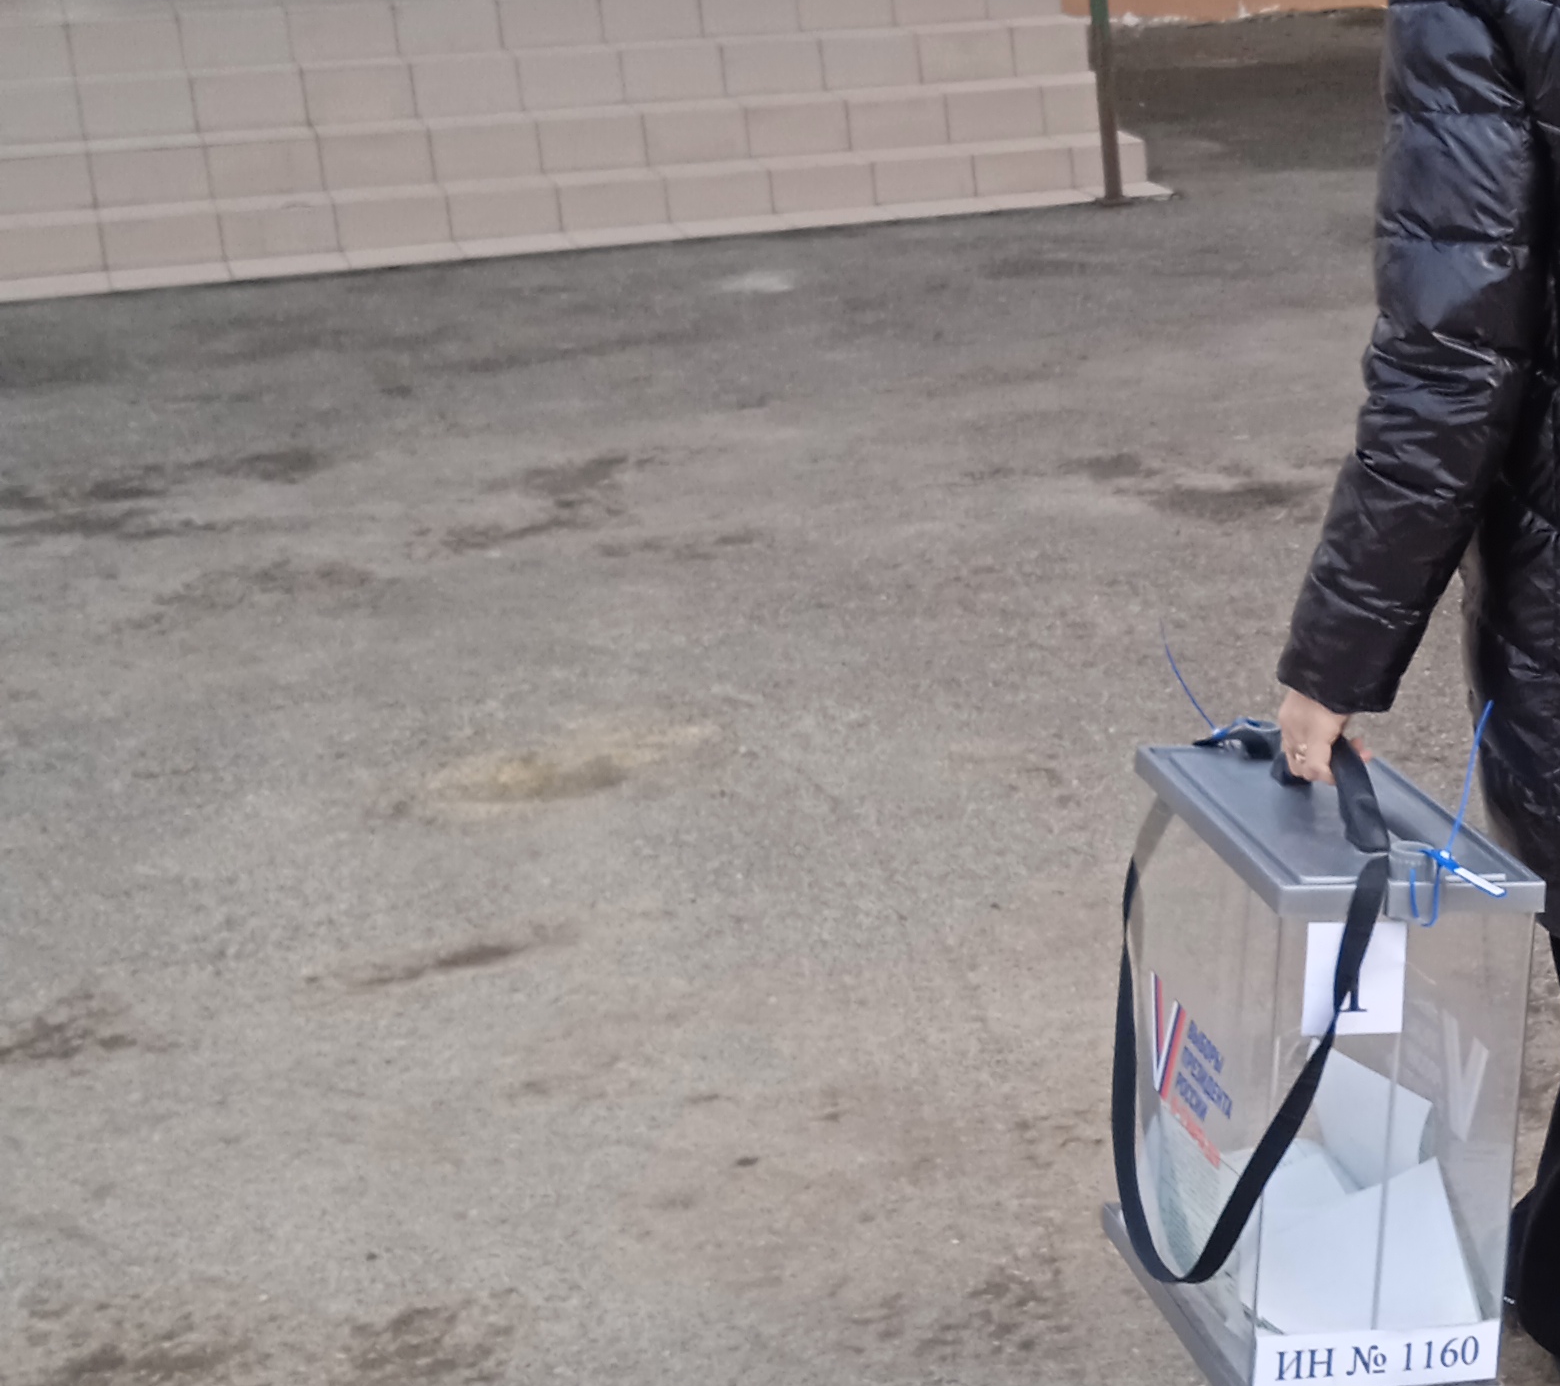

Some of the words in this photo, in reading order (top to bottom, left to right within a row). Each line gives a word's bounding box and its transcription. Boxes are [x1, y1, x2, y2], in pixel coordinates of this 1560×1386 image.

[1275, 1347, 1334, 1381] ИН
[1346, 1344, 1387, 1376] №
[1403, 1335, 1480, 1371] 1160
